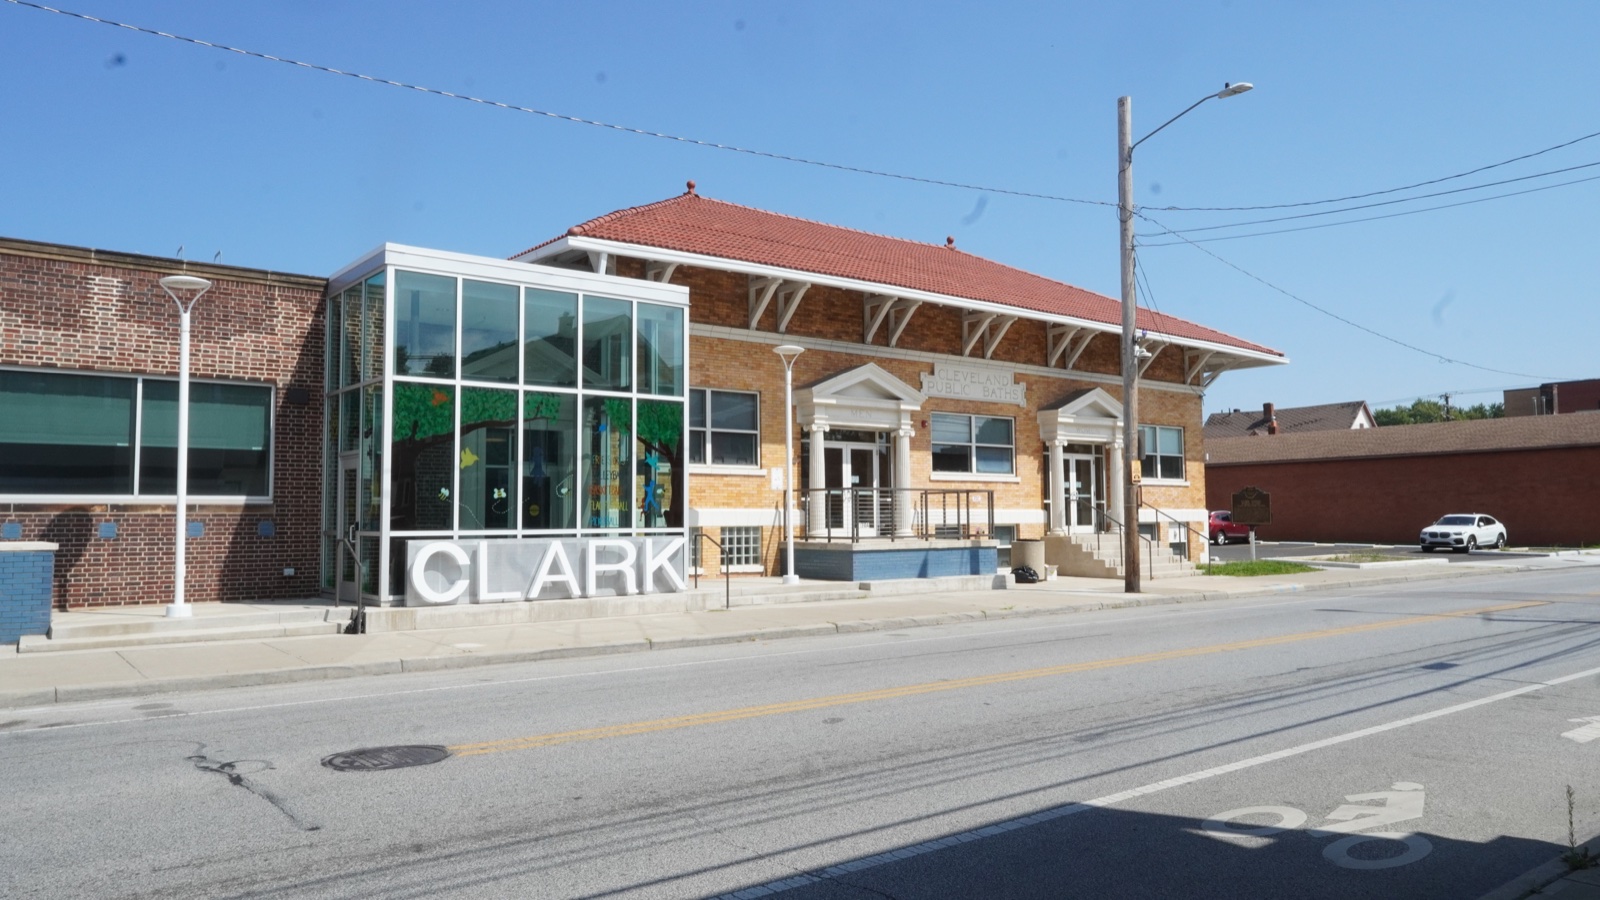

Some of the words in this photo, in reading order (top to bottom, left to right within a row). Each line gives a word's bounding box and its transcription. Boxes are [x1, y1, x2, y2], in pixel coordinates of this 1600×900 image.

[937, 368, 1009, 387] CLEVELAND
[927, 381, 971, 396] PUBLIC
[982, 386, 1019, 401] BATHS
[850, 408, 872, 419] MEN
[411, 537, 688, 603] CLARK
